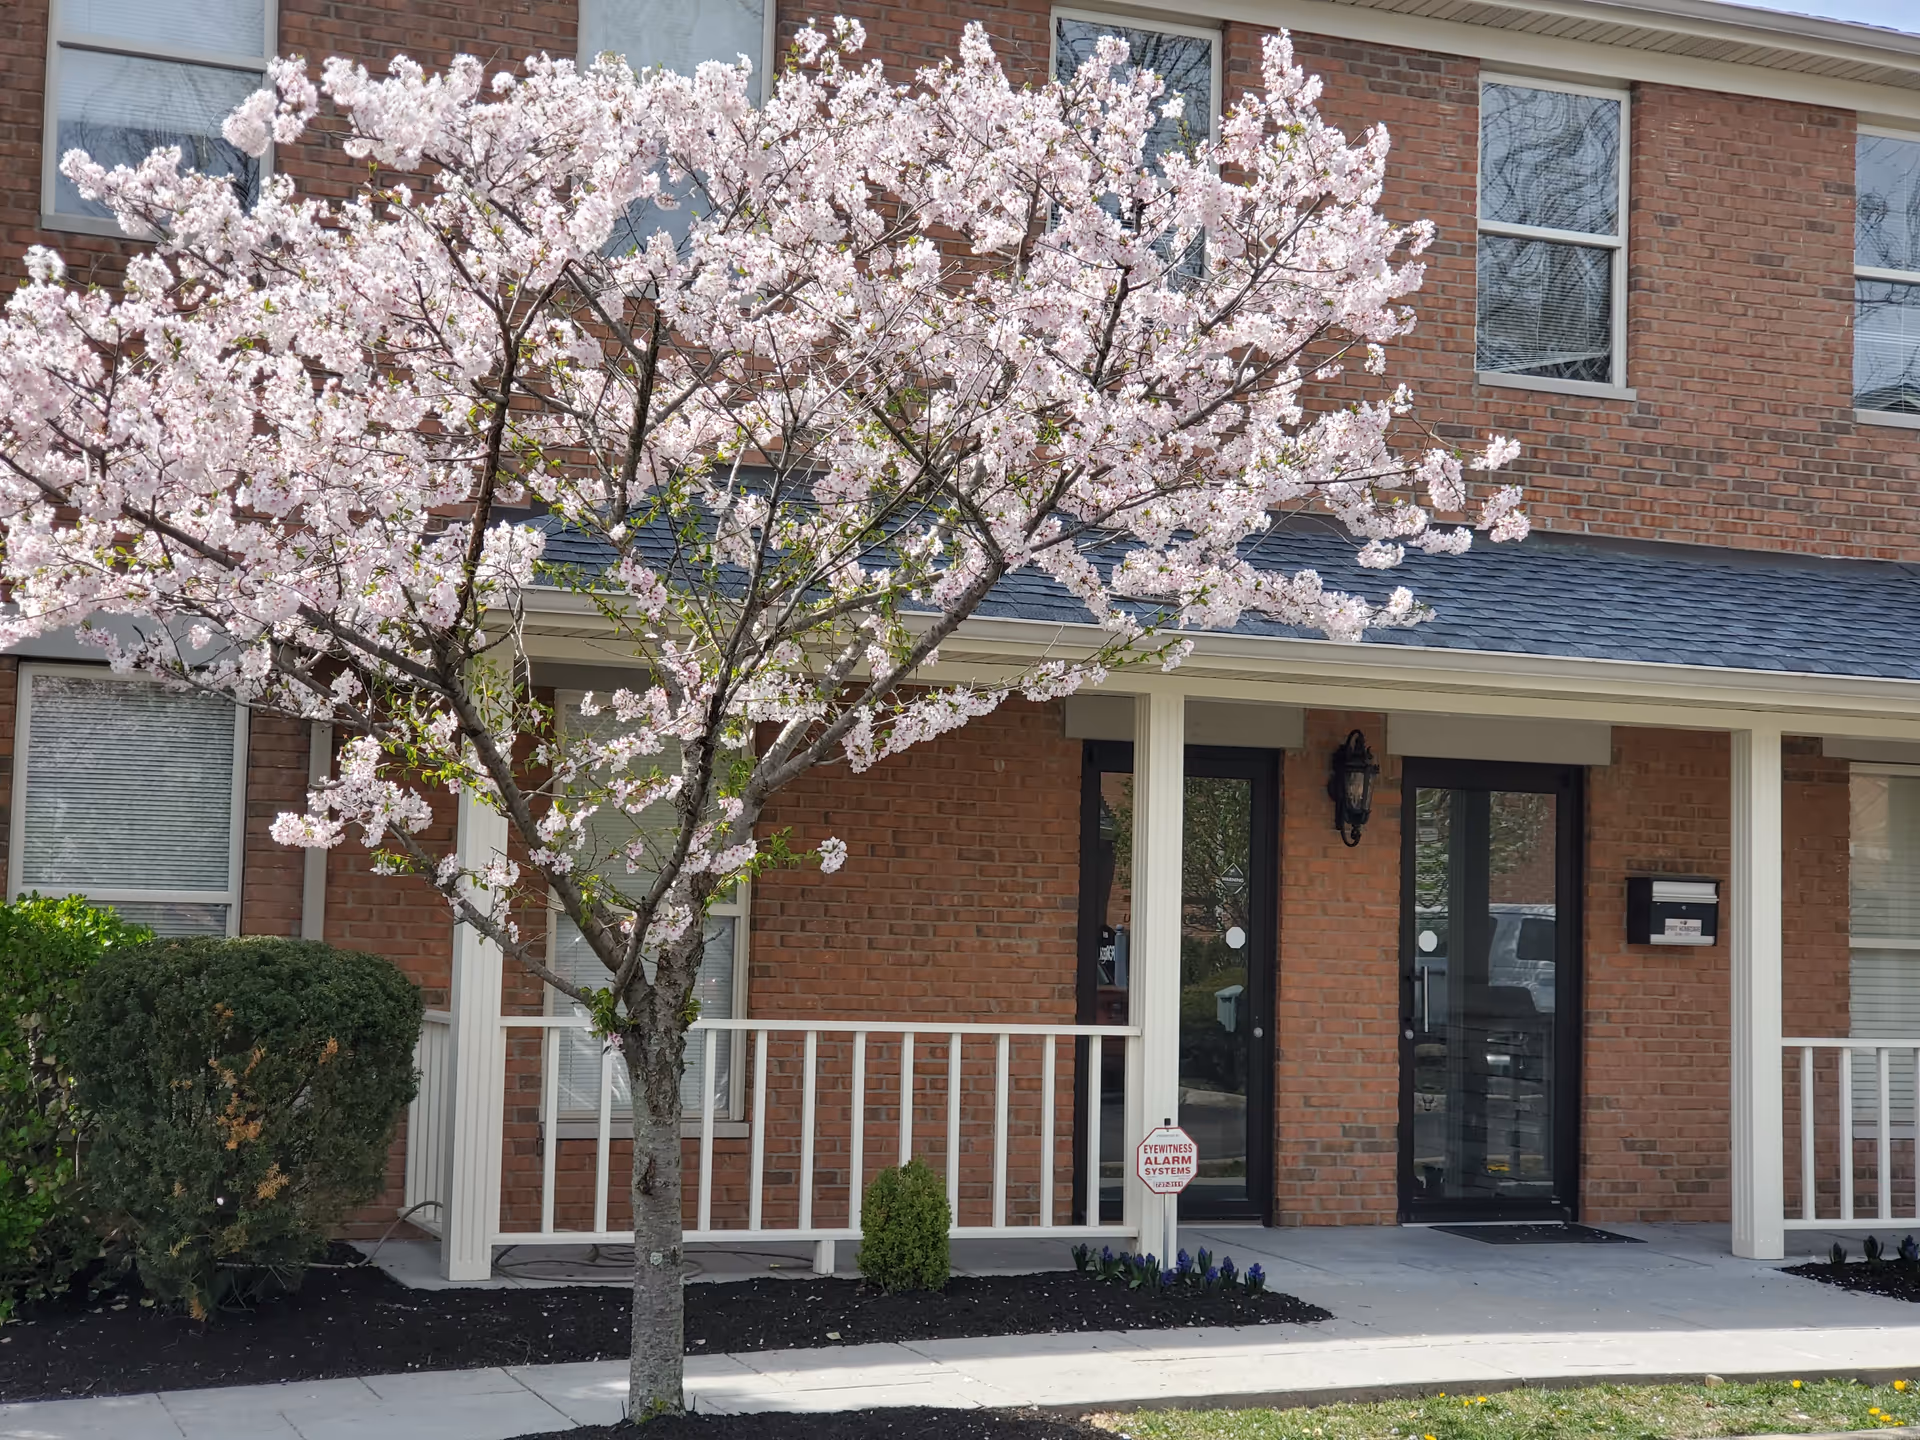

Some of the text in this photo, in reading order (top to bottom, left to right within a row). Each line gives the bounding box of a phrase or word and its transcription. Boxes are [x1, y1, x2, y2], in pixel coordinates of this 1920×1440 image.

[1143, 1143, 1193, 1154] EYEWITNESS
[1144, 1156, 1192, 1166] ALARM
[1144, 1167, 1191, 1176] SYSTEMS
